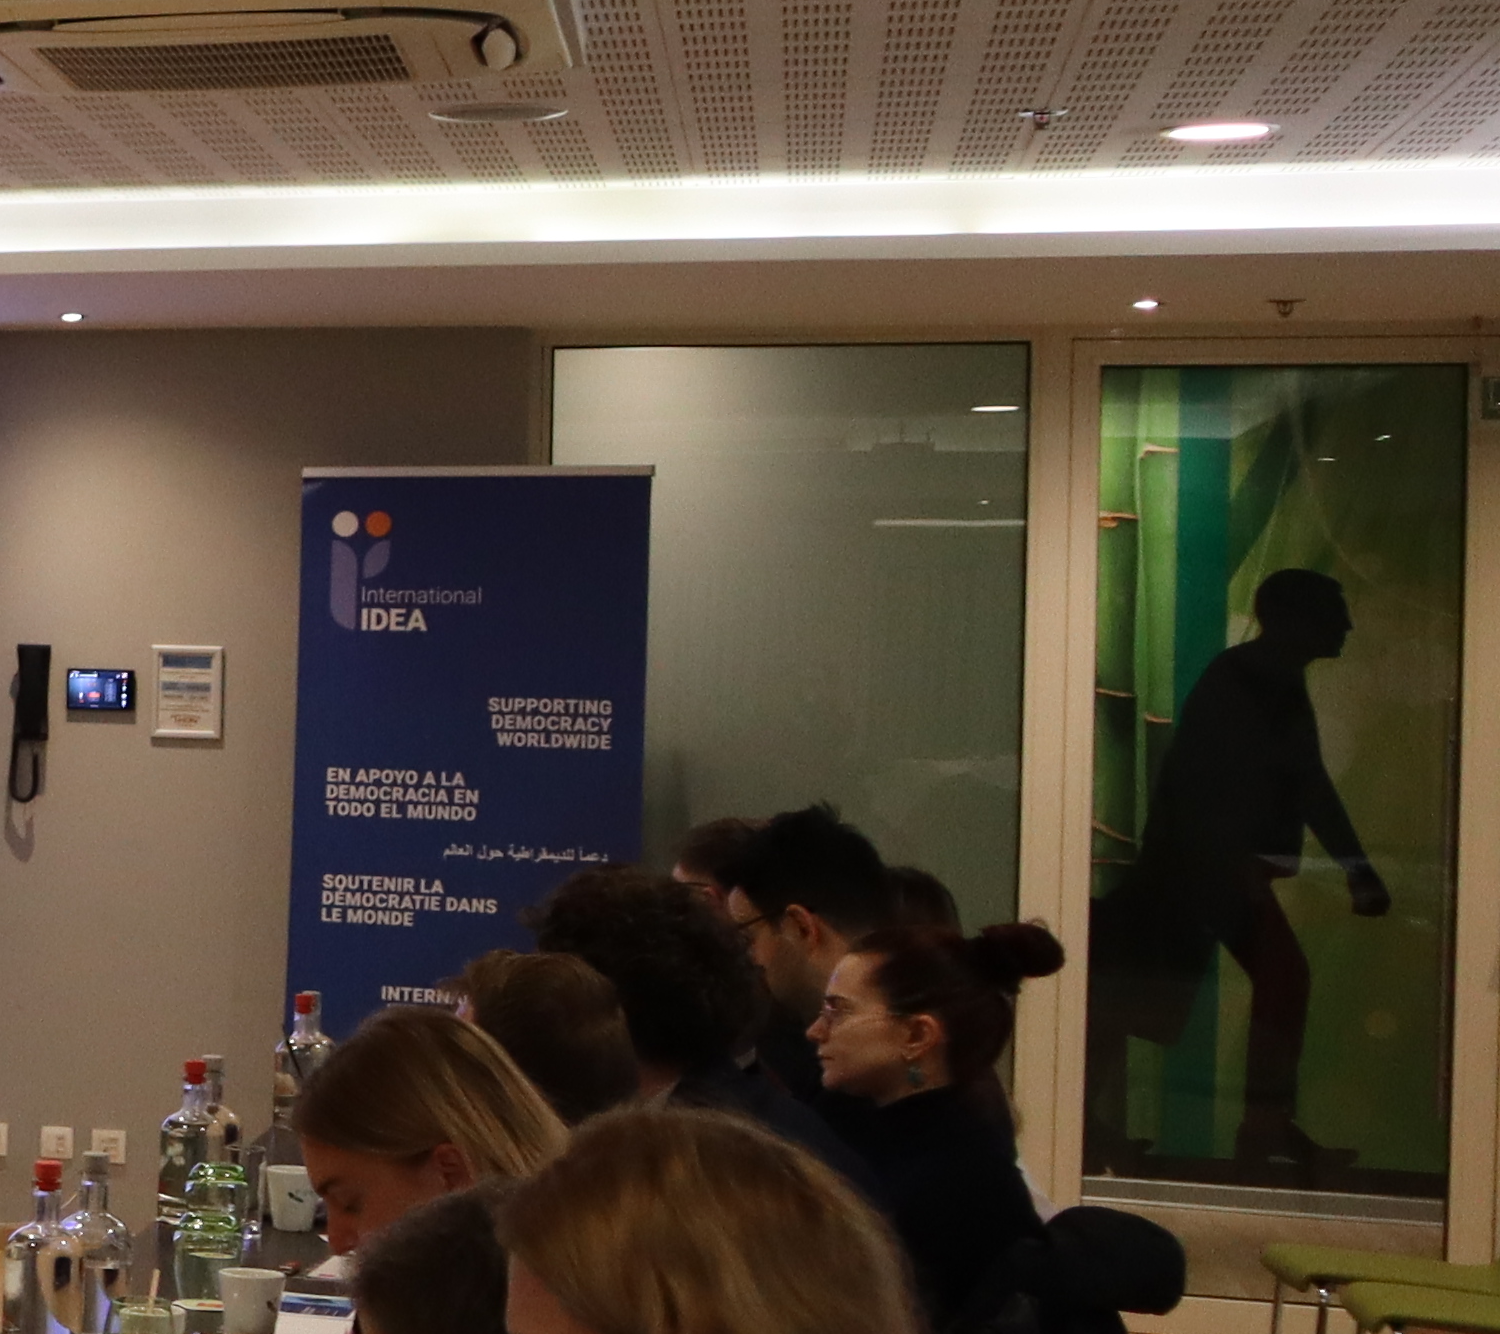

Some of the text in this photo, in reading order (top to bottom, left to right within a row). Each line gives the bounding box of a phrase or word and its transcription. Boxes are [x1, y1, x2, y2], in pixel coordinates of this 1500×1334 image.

[361, 585, 483, 605] International
[360, 608, 427, 631] IDEA
[488, 697, 612, 716] SUPPORTING
[490, 714, 612, 733] DEMOCRACY
[496, 731, 612, 750] WORLDWIDE
[326, 767, 465, 788] EN APOYO A LA
[325, 784, 479, 806] DEMOCRACIA EN
[325, 801, 477, 822] TODO EL MUNDO
[442, 843, 473, 861] العالم
[476, 844, 504, 861] حول
[322, 874, 444, 894] SOUTENIR LA
[321, 885, 498, 915] DÉMOCRATIE DANS
[321, 908, 414, 927] LE MONDE
[381, 985, 451, 1005] INTERN
